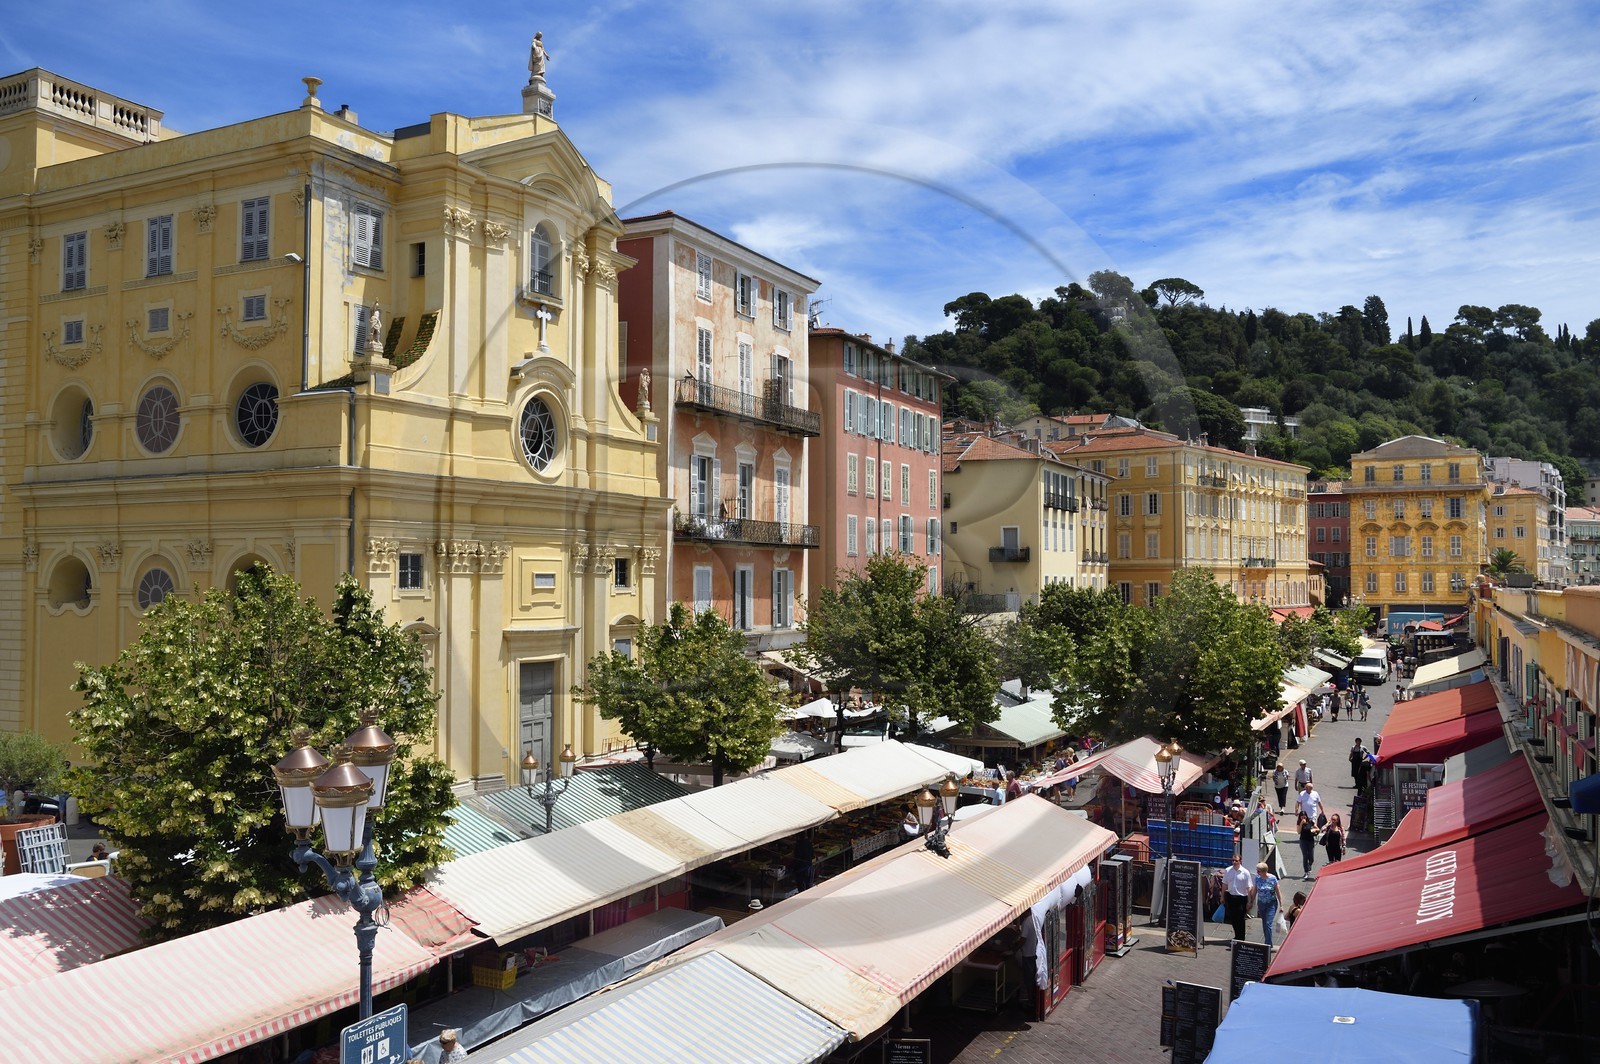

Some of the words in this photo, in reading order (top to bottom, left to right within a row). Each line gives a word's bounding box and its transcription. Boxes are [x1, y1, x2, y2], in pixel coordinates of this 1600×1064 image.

[1425, 850, 1457, 880] CHEZ
[1416, 877, 1457, 925] FREDDY
[348, 1026, 374, 1043] TOILETTES
[374, 1014, 402, 1032] PUBLIQUES
[366, 1029, 385, 1045] SALEYA
